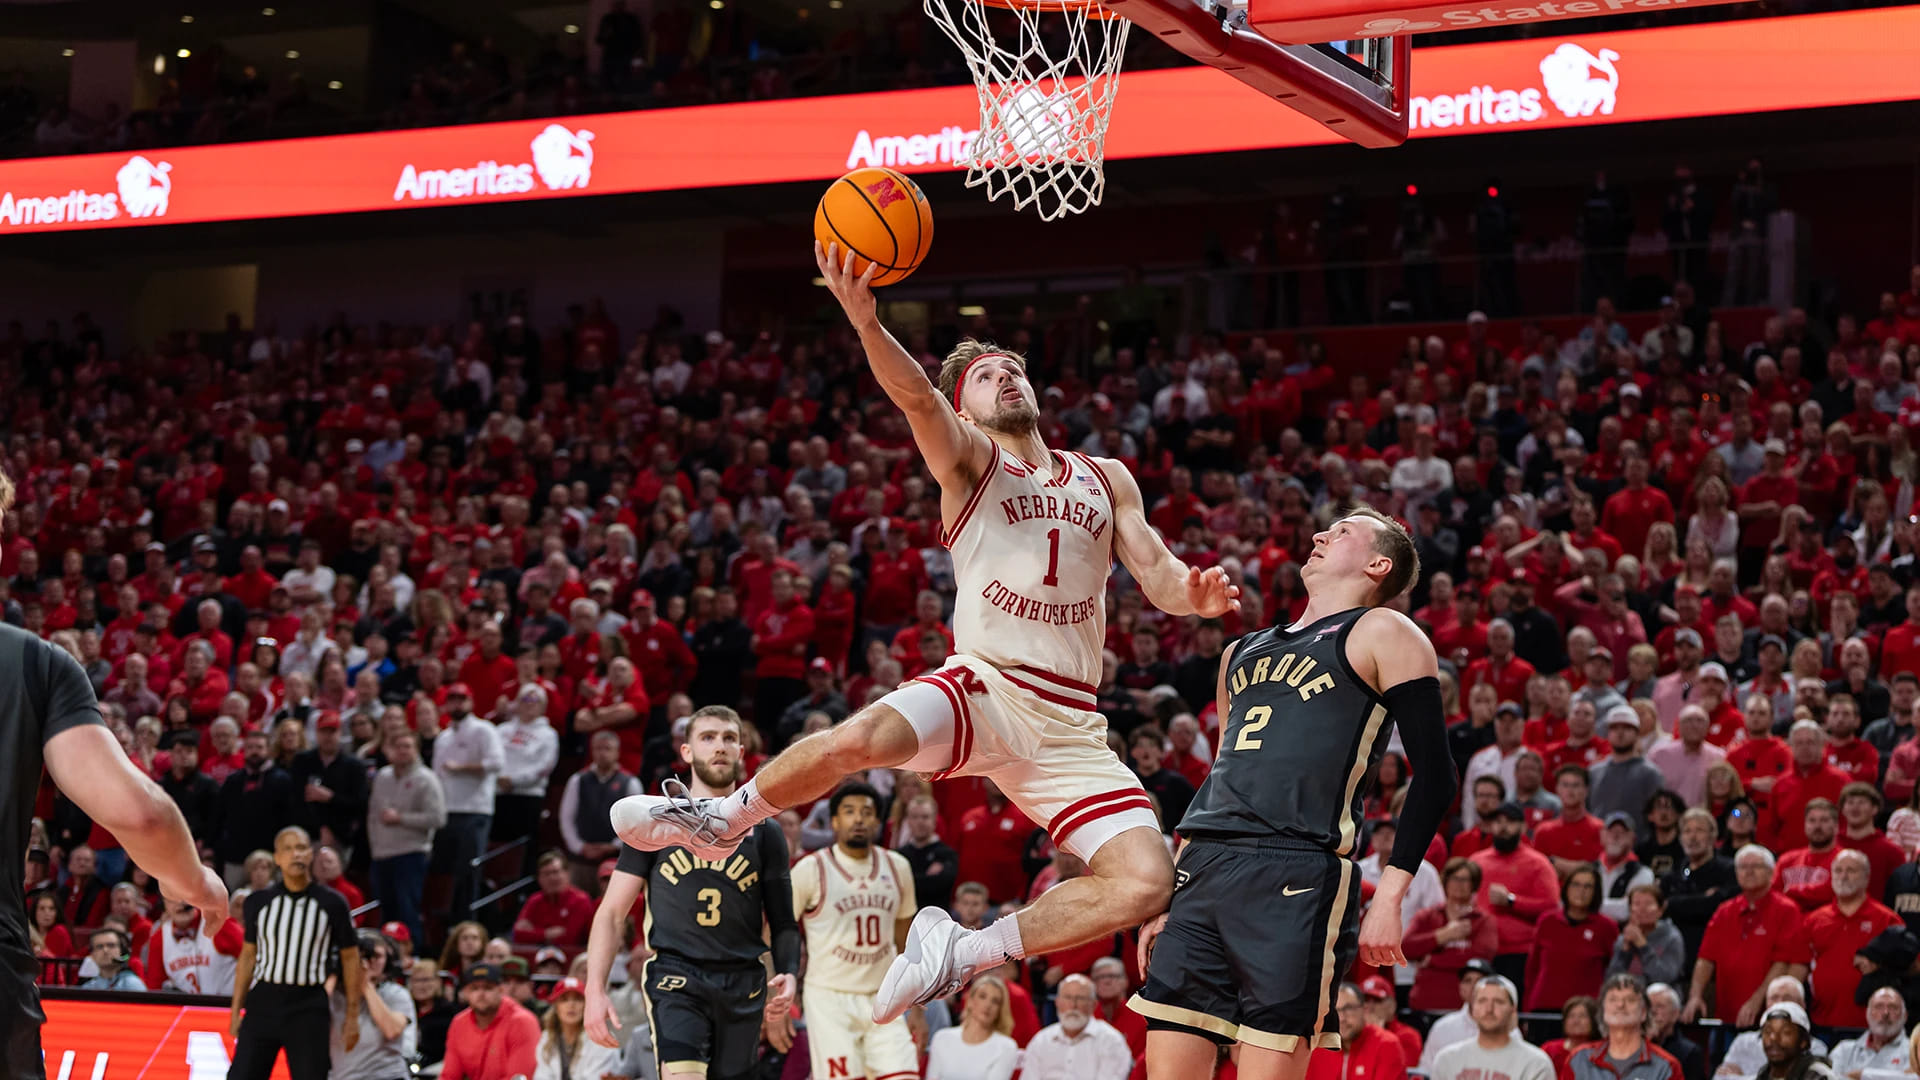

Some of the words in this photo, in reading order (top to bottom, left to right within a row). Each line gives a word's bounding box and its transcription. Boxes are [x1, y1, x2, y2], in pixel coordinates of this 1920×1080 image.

[393, 160, 534, 201] Ameritas
[866, 177, 906, 209] N
[0, 189, 118, 225] Ameritas
[1000, 494, 1107, 541] NEBRASKA
[1042, 527, 1061, 588] 1
[981, 579, 1096, 626] CORNHUSKERS
[1228, 652, 1336, 702] URDUE
[1233, 705, 1273, 751] 2
[696, 887, 722, 928] 3
[855, 914, 881, 948] 10
[656, 975, 688, 992] P
[827, 1056, 849, 1078] N
